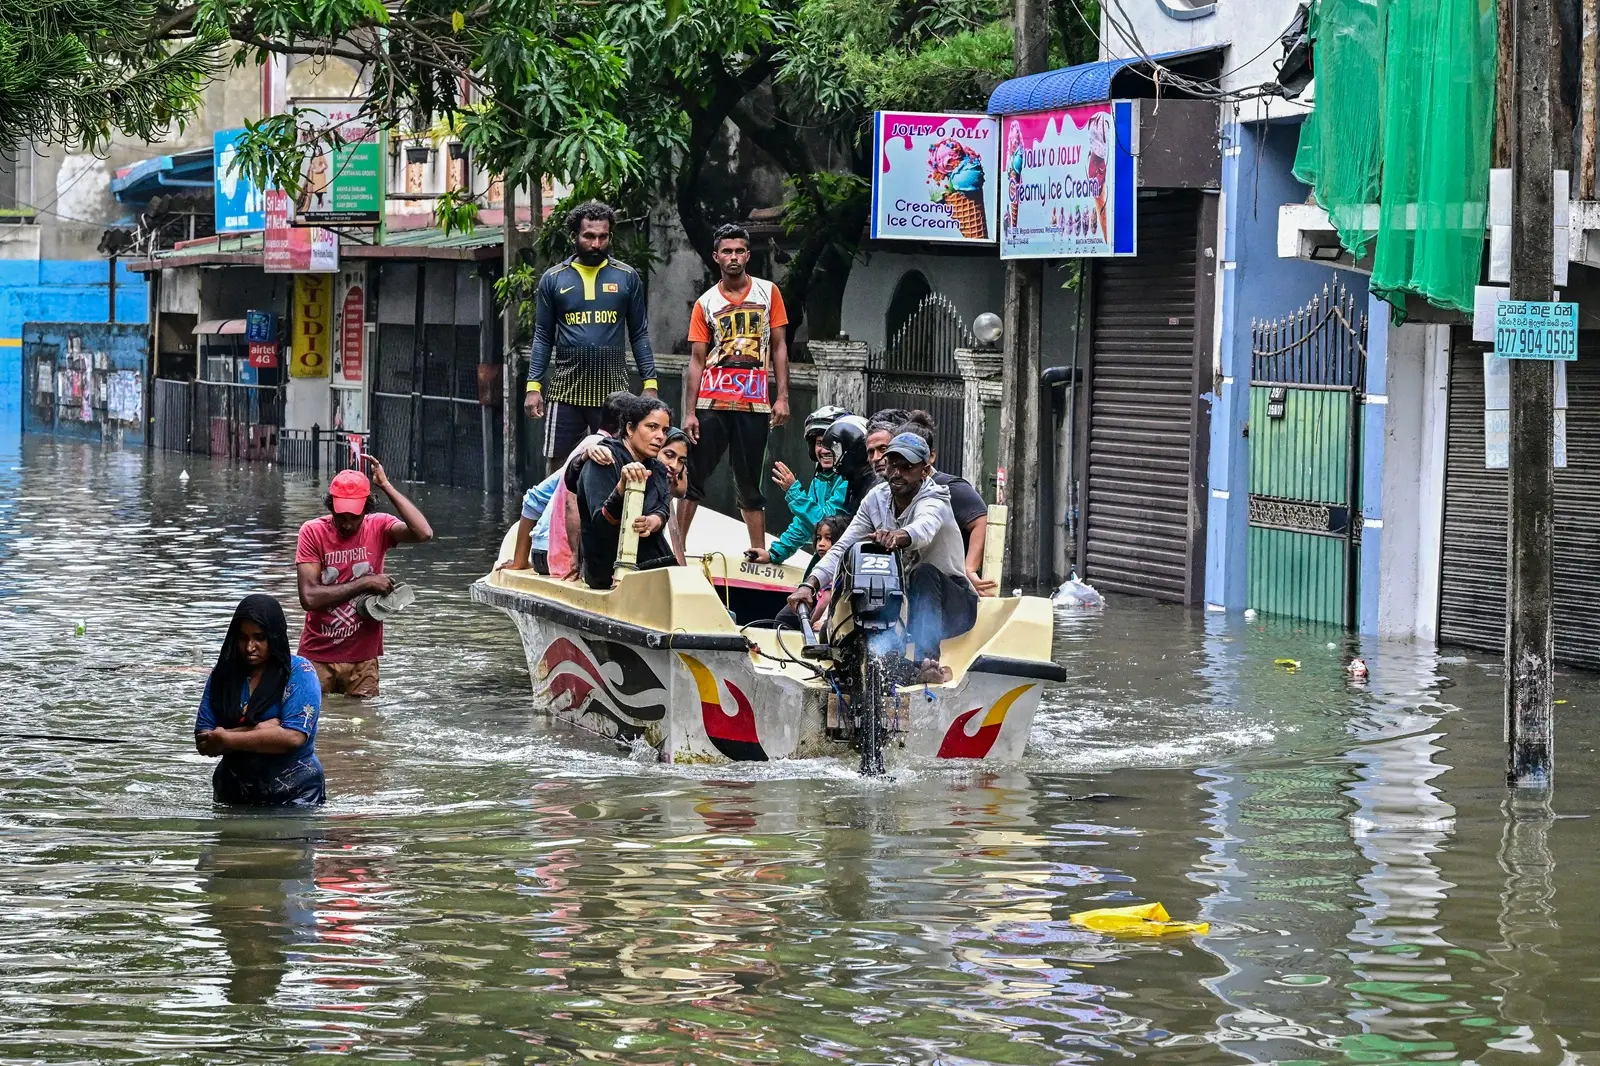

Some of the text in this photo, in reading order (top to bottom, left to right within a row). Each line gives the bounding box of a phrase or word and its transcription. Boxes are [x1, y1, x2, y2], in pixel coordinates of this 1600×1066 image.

[892, 124, 990, 139] JOLLY O JOLLY
[1023, 145, 1081, 168] JOLLY O JOLLY
[1008, 174, 1101, 207] Creamy Ice Cream
[266, 196, 274, 211] Sri
[895, 199, 954, 217] Creamy
[887, 214, 960, 229] Ice Cream
[565, 310, 618, 325] GREAT BOYS
[1498, 303, 1527, 316] උකස්
[1530, 305, 1550, 318] කළ
[301, 273, 324, 367] STUDIO
[1497, 328, 1575, 355] 077 904 0503
[251, 345, 275, 354] airtel
[255, 355, 270, 364] 4G
[861, 556, 891, 569] 25
[740, 562, 785, 580] SNL-514
